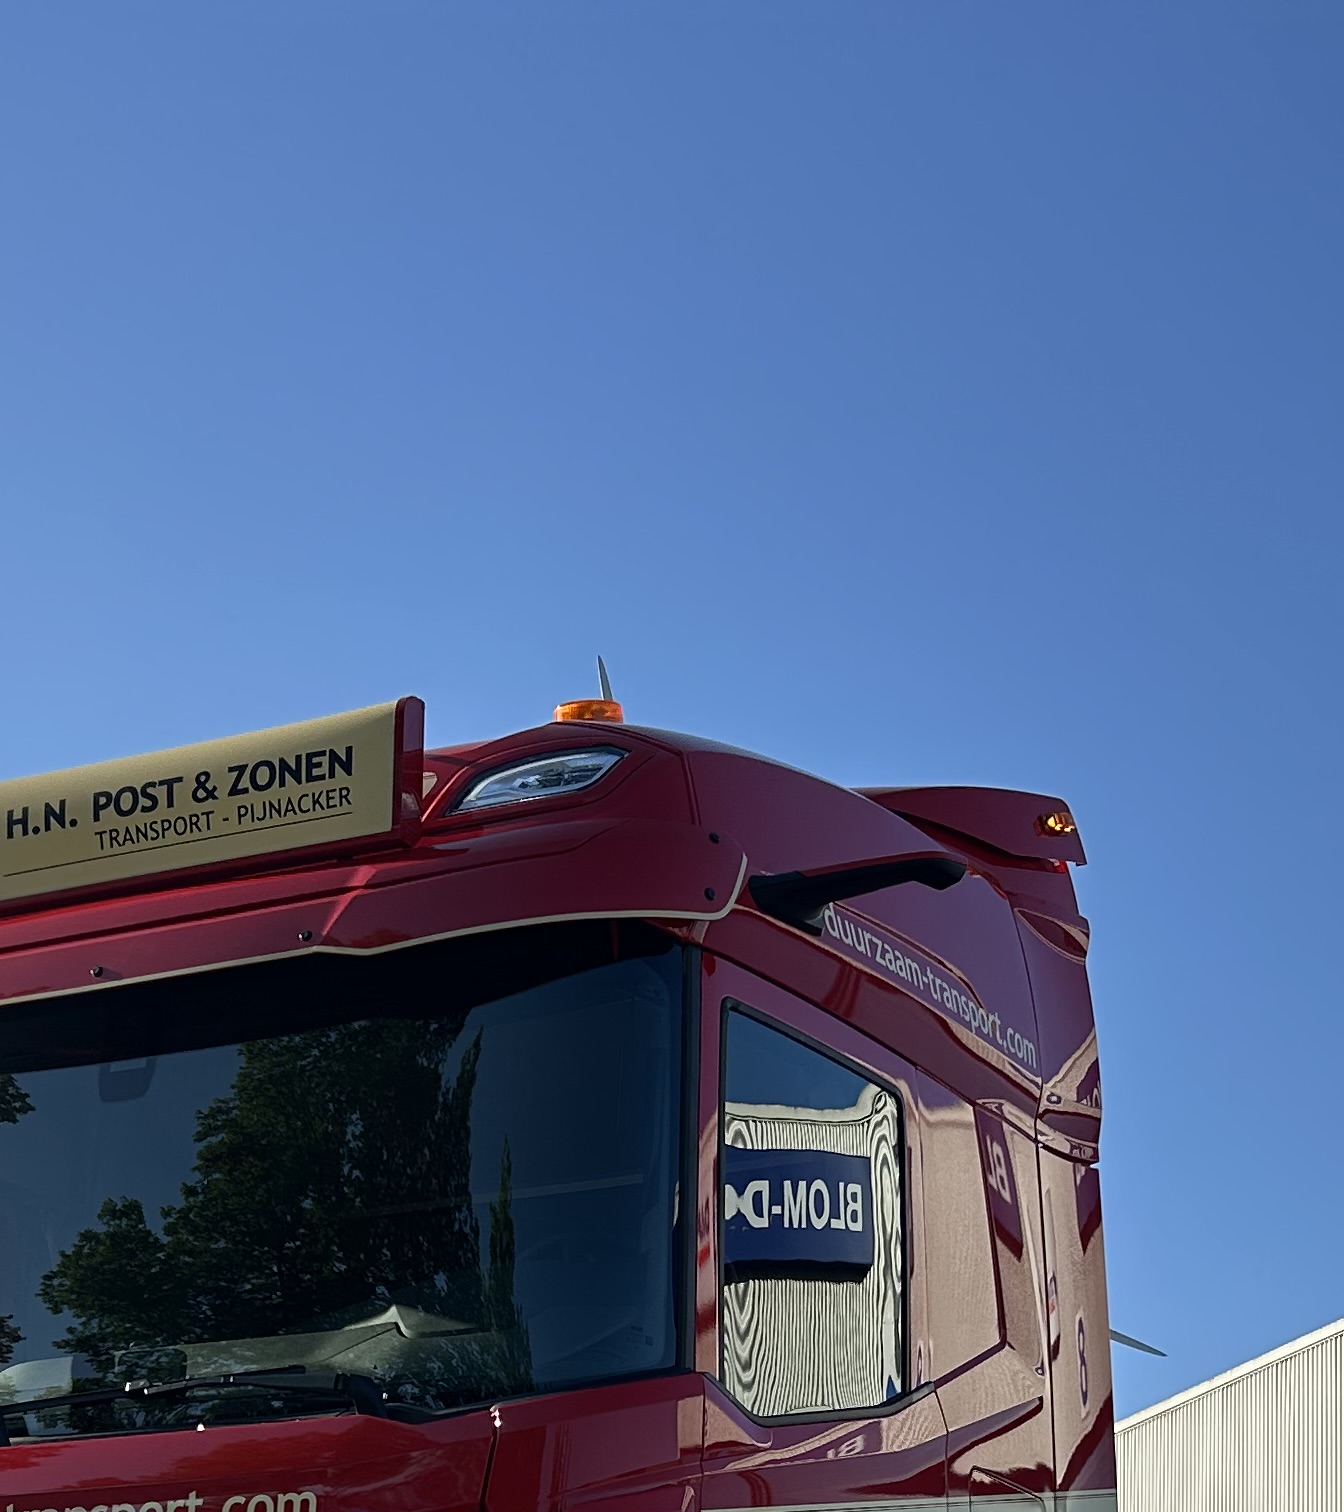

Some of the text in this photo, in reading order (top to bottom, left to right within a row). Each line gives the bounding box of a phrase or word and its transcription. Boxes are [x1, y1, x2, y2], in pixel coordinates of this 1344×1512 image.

[6, 745, 354, 840] H.N. POST & ZONEN
[94, 810, 215, 851] TRANSPORT
[236, 786, 353, 826] PIJNACKER
[823, 901, 1038, 1070] duurzaam-transport.com
